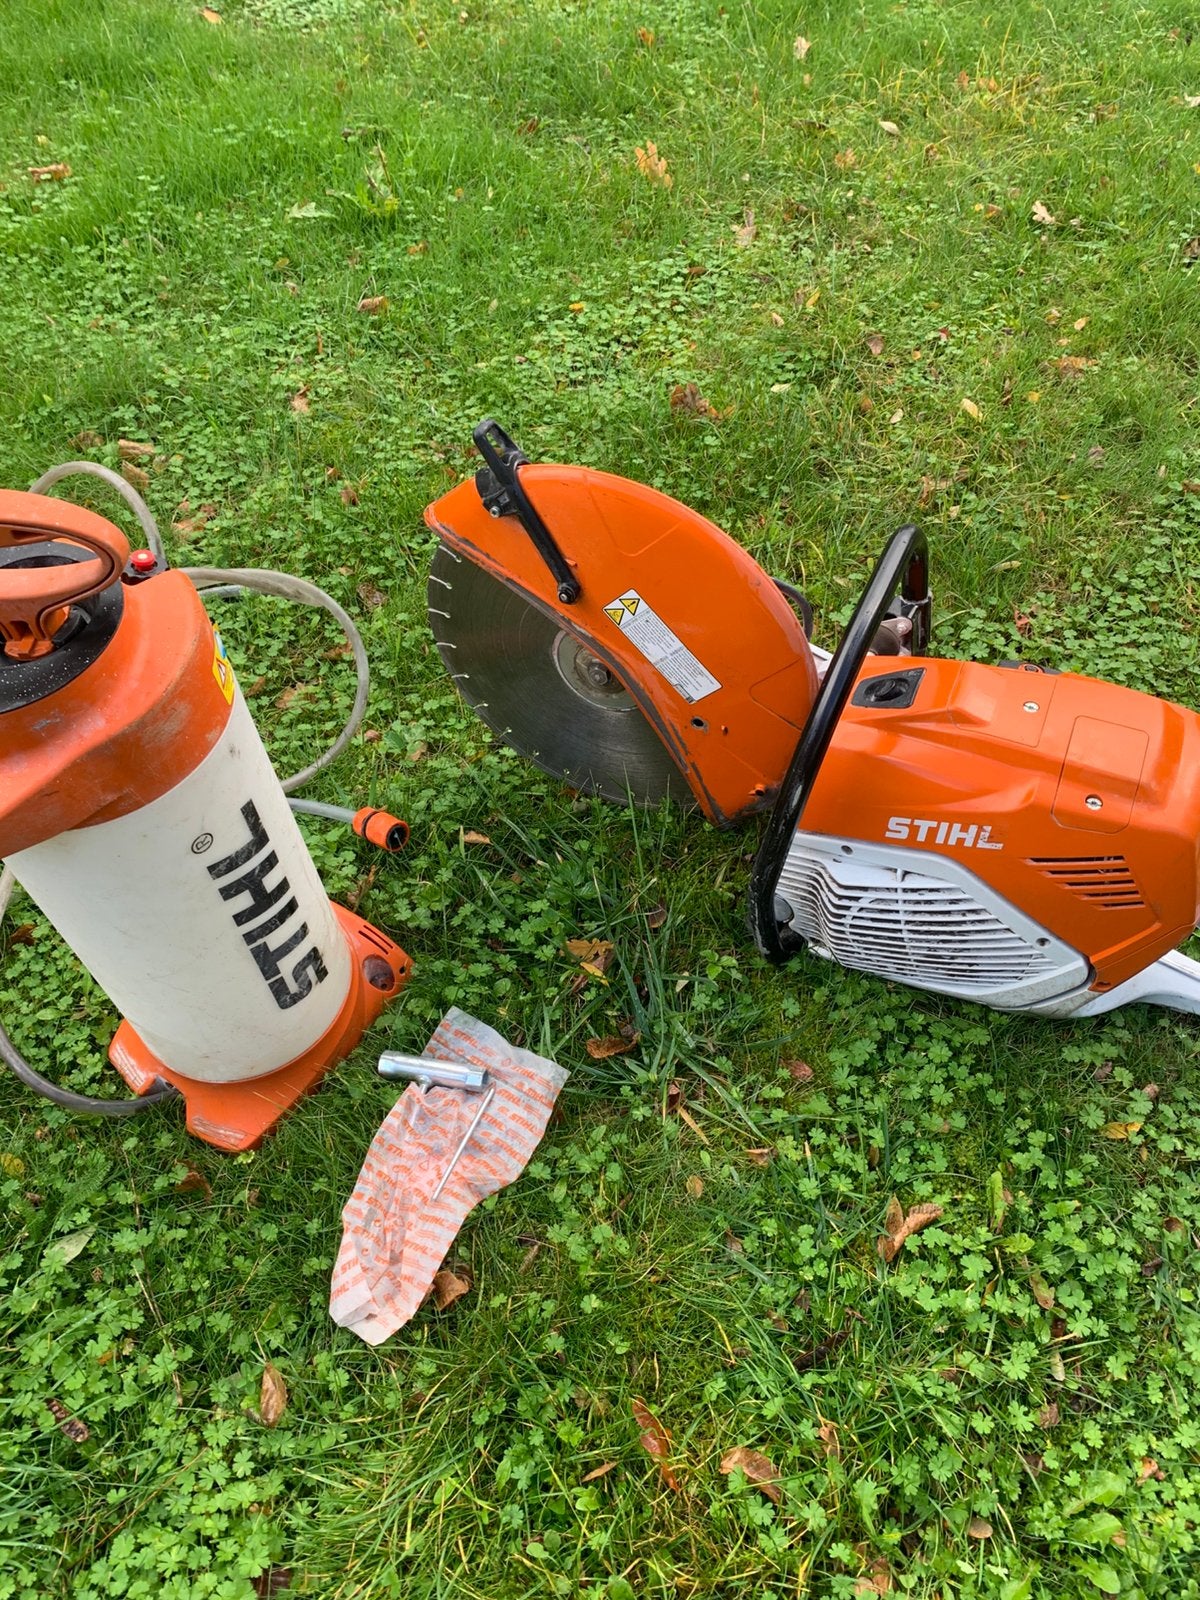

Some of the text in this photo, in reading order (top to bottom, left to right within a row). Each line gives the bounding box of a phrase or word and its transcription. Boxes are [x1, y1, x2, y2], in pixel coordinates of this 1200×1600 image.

[885, 816, 1004, 851] STIHL
[207, 798, 328, 1010] STIHL
[453, 1029, 478, 1048] STIHL
[509, 1113, 535, 1133] STIHL
[419, 1213, 445, 1226] STIHL
